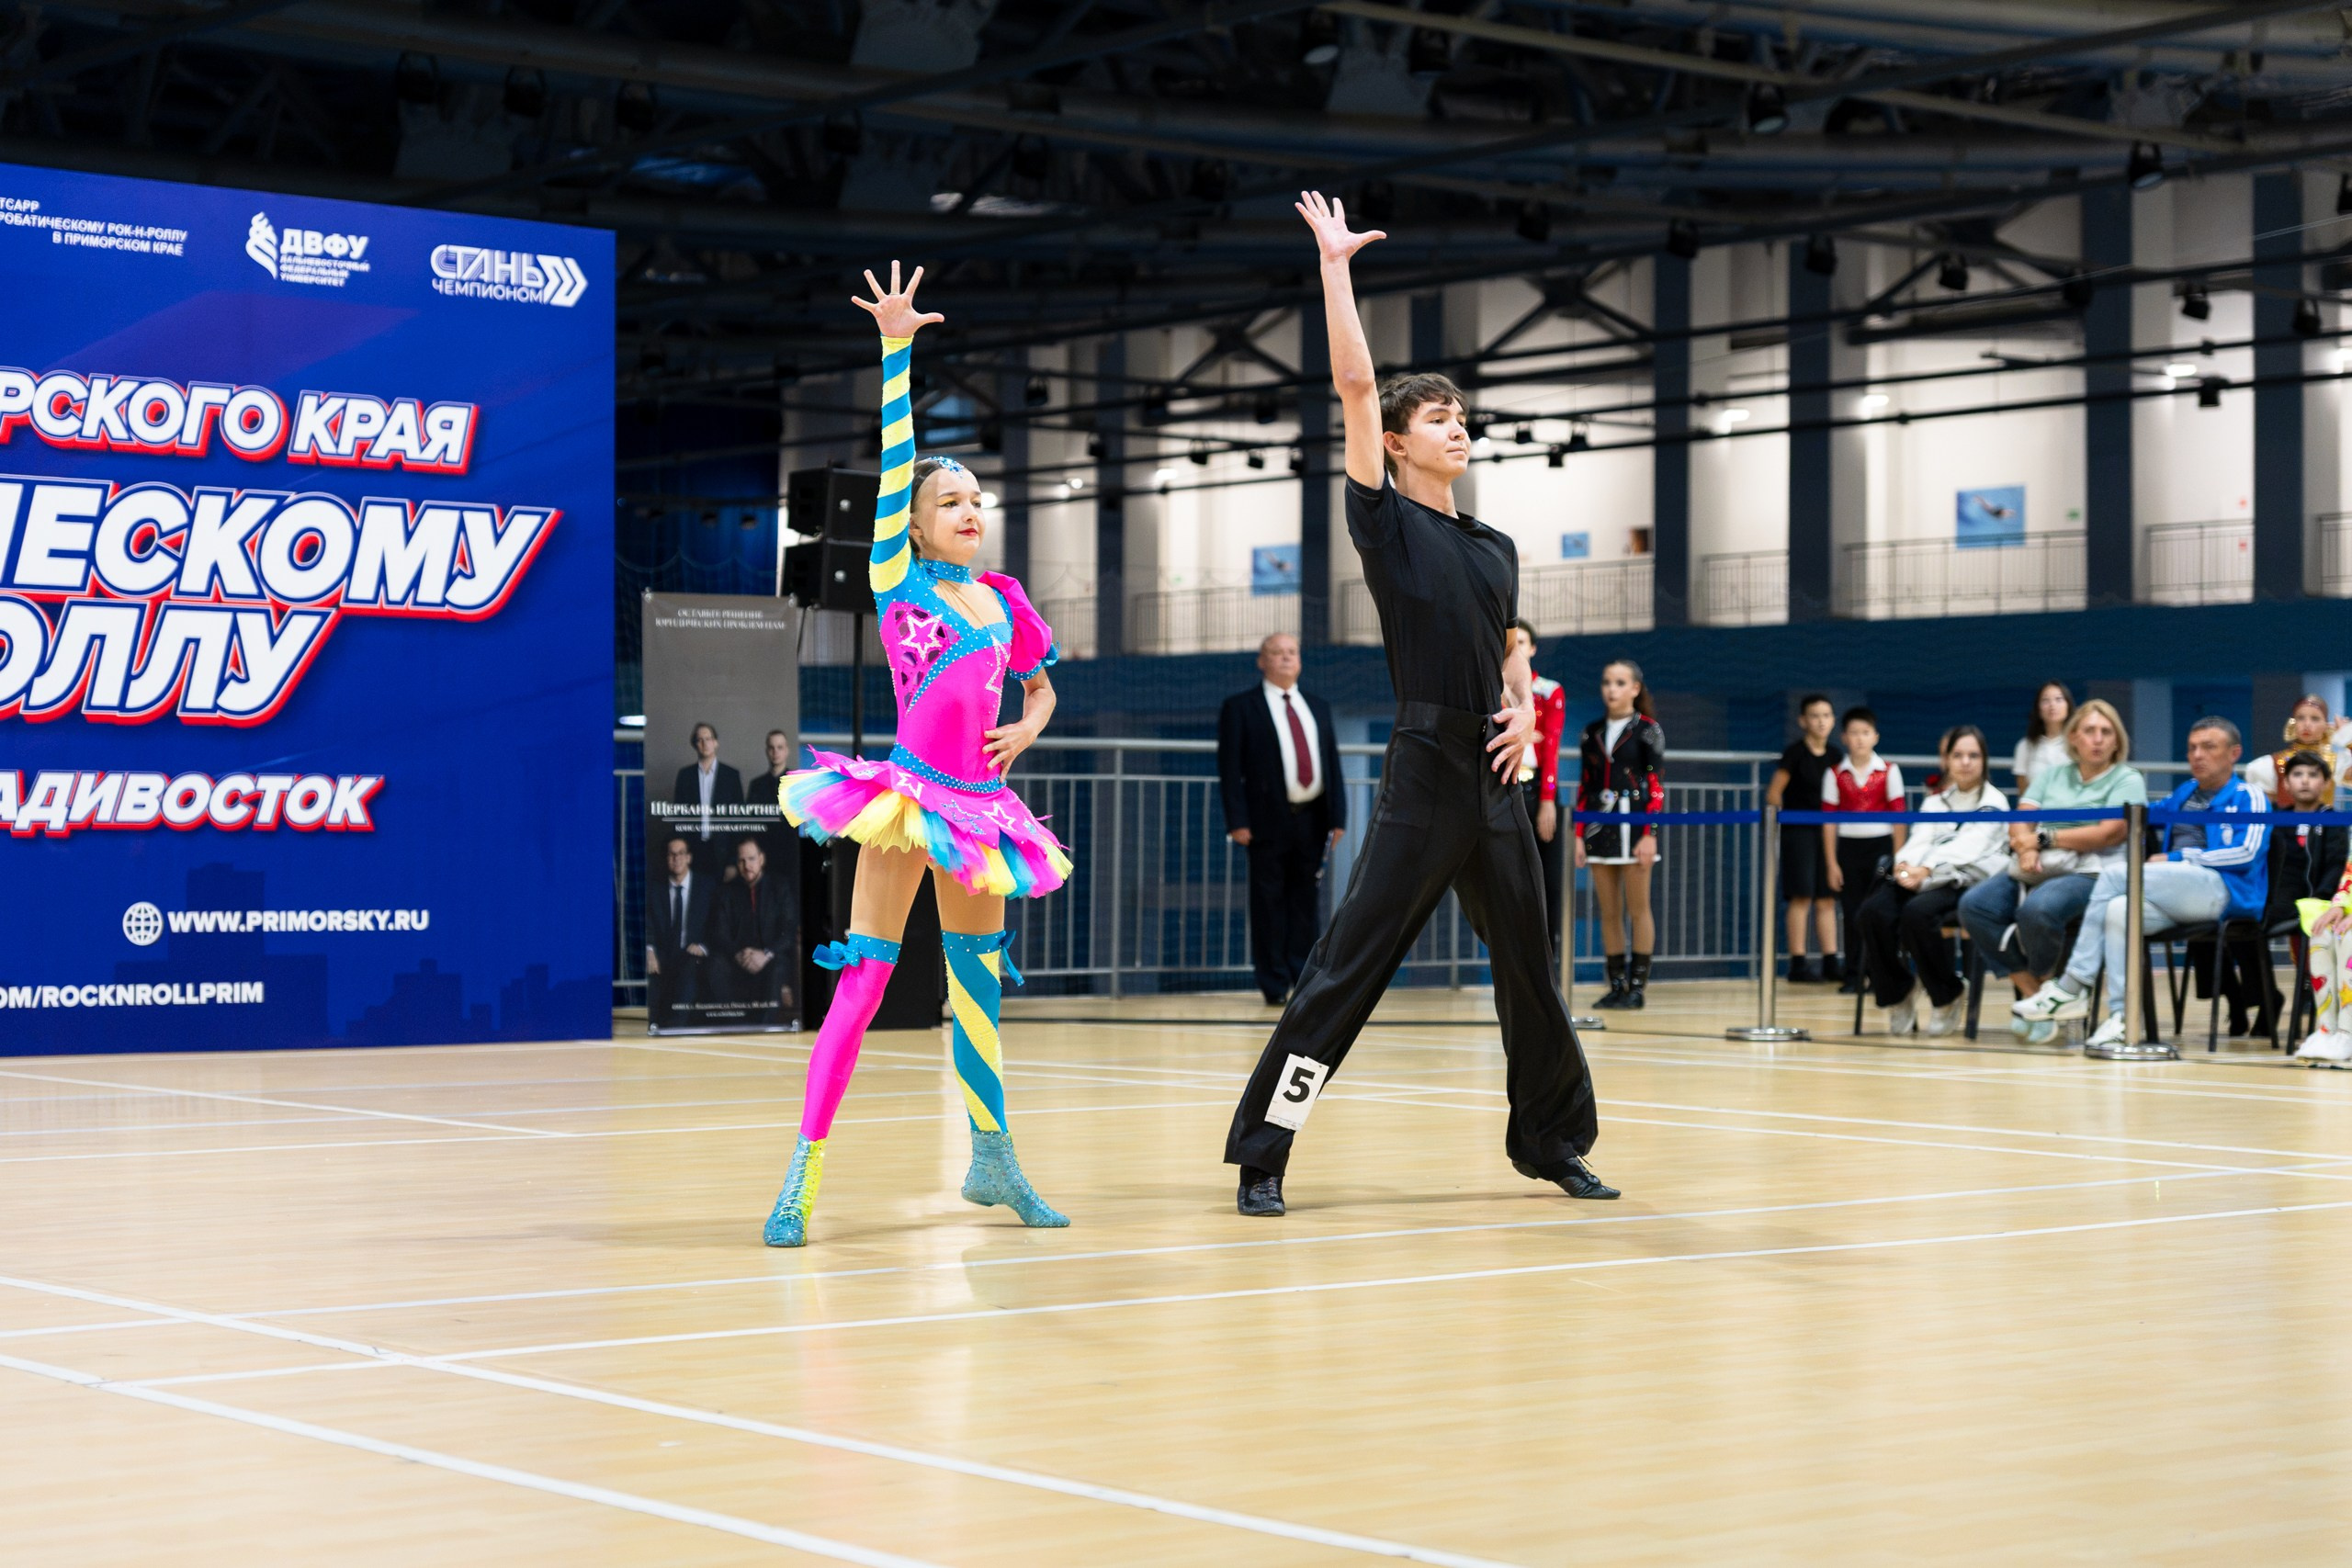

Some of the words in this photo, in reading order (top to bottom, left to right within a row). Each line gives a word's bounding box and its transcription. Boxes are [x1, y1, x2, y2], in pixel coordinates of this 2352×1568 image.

[52, 231, 62, 244] В
[64, 232, 150, 253] ПРИМОРСКОМ
[153, 241, 184, 256] КРАЕ
[107, 222, 187, 243] РОК-Н-РОЛЛУ
[280, 228, 369, 260] ДВФУ
[430, 244, 546, 288] СТАНЬ
[432, 278, 544, 305] ЧЕМПИОНОМ
[0, 367, 288, 461] РСКОГО
[288, 390, 480, 476] КРАЯ
[168, 908, 430, 934] WWW.PRIMORSKY.RU
[1283, 1066, 1316, 1103] 5
